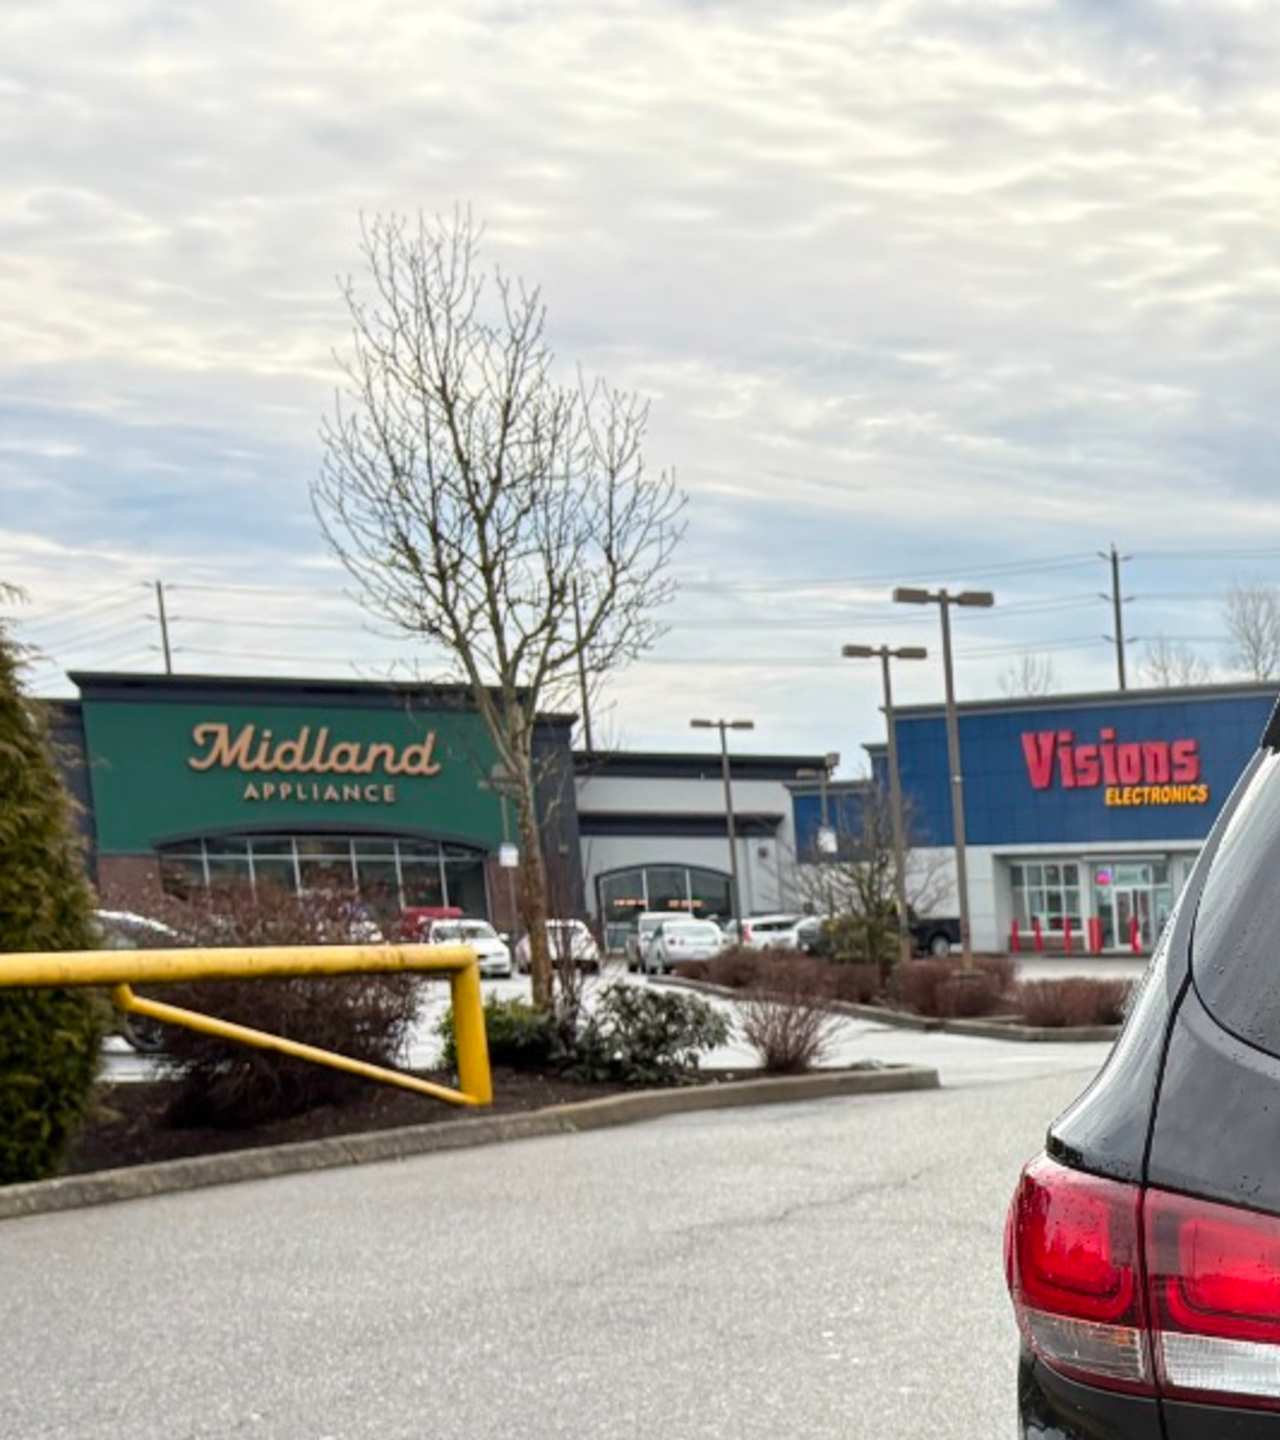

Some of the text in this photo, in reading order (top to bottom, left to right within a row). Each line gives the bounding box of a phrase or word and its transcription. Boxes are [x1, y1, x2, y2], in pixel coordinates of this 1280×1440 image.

[188, 722, 442, 775] Midland
[1021, 727, 1199, 789] Visions
[243, 781, 397, 802] APPLIANCE
[1105, 784, 1210, 807] ELECTRONICS
